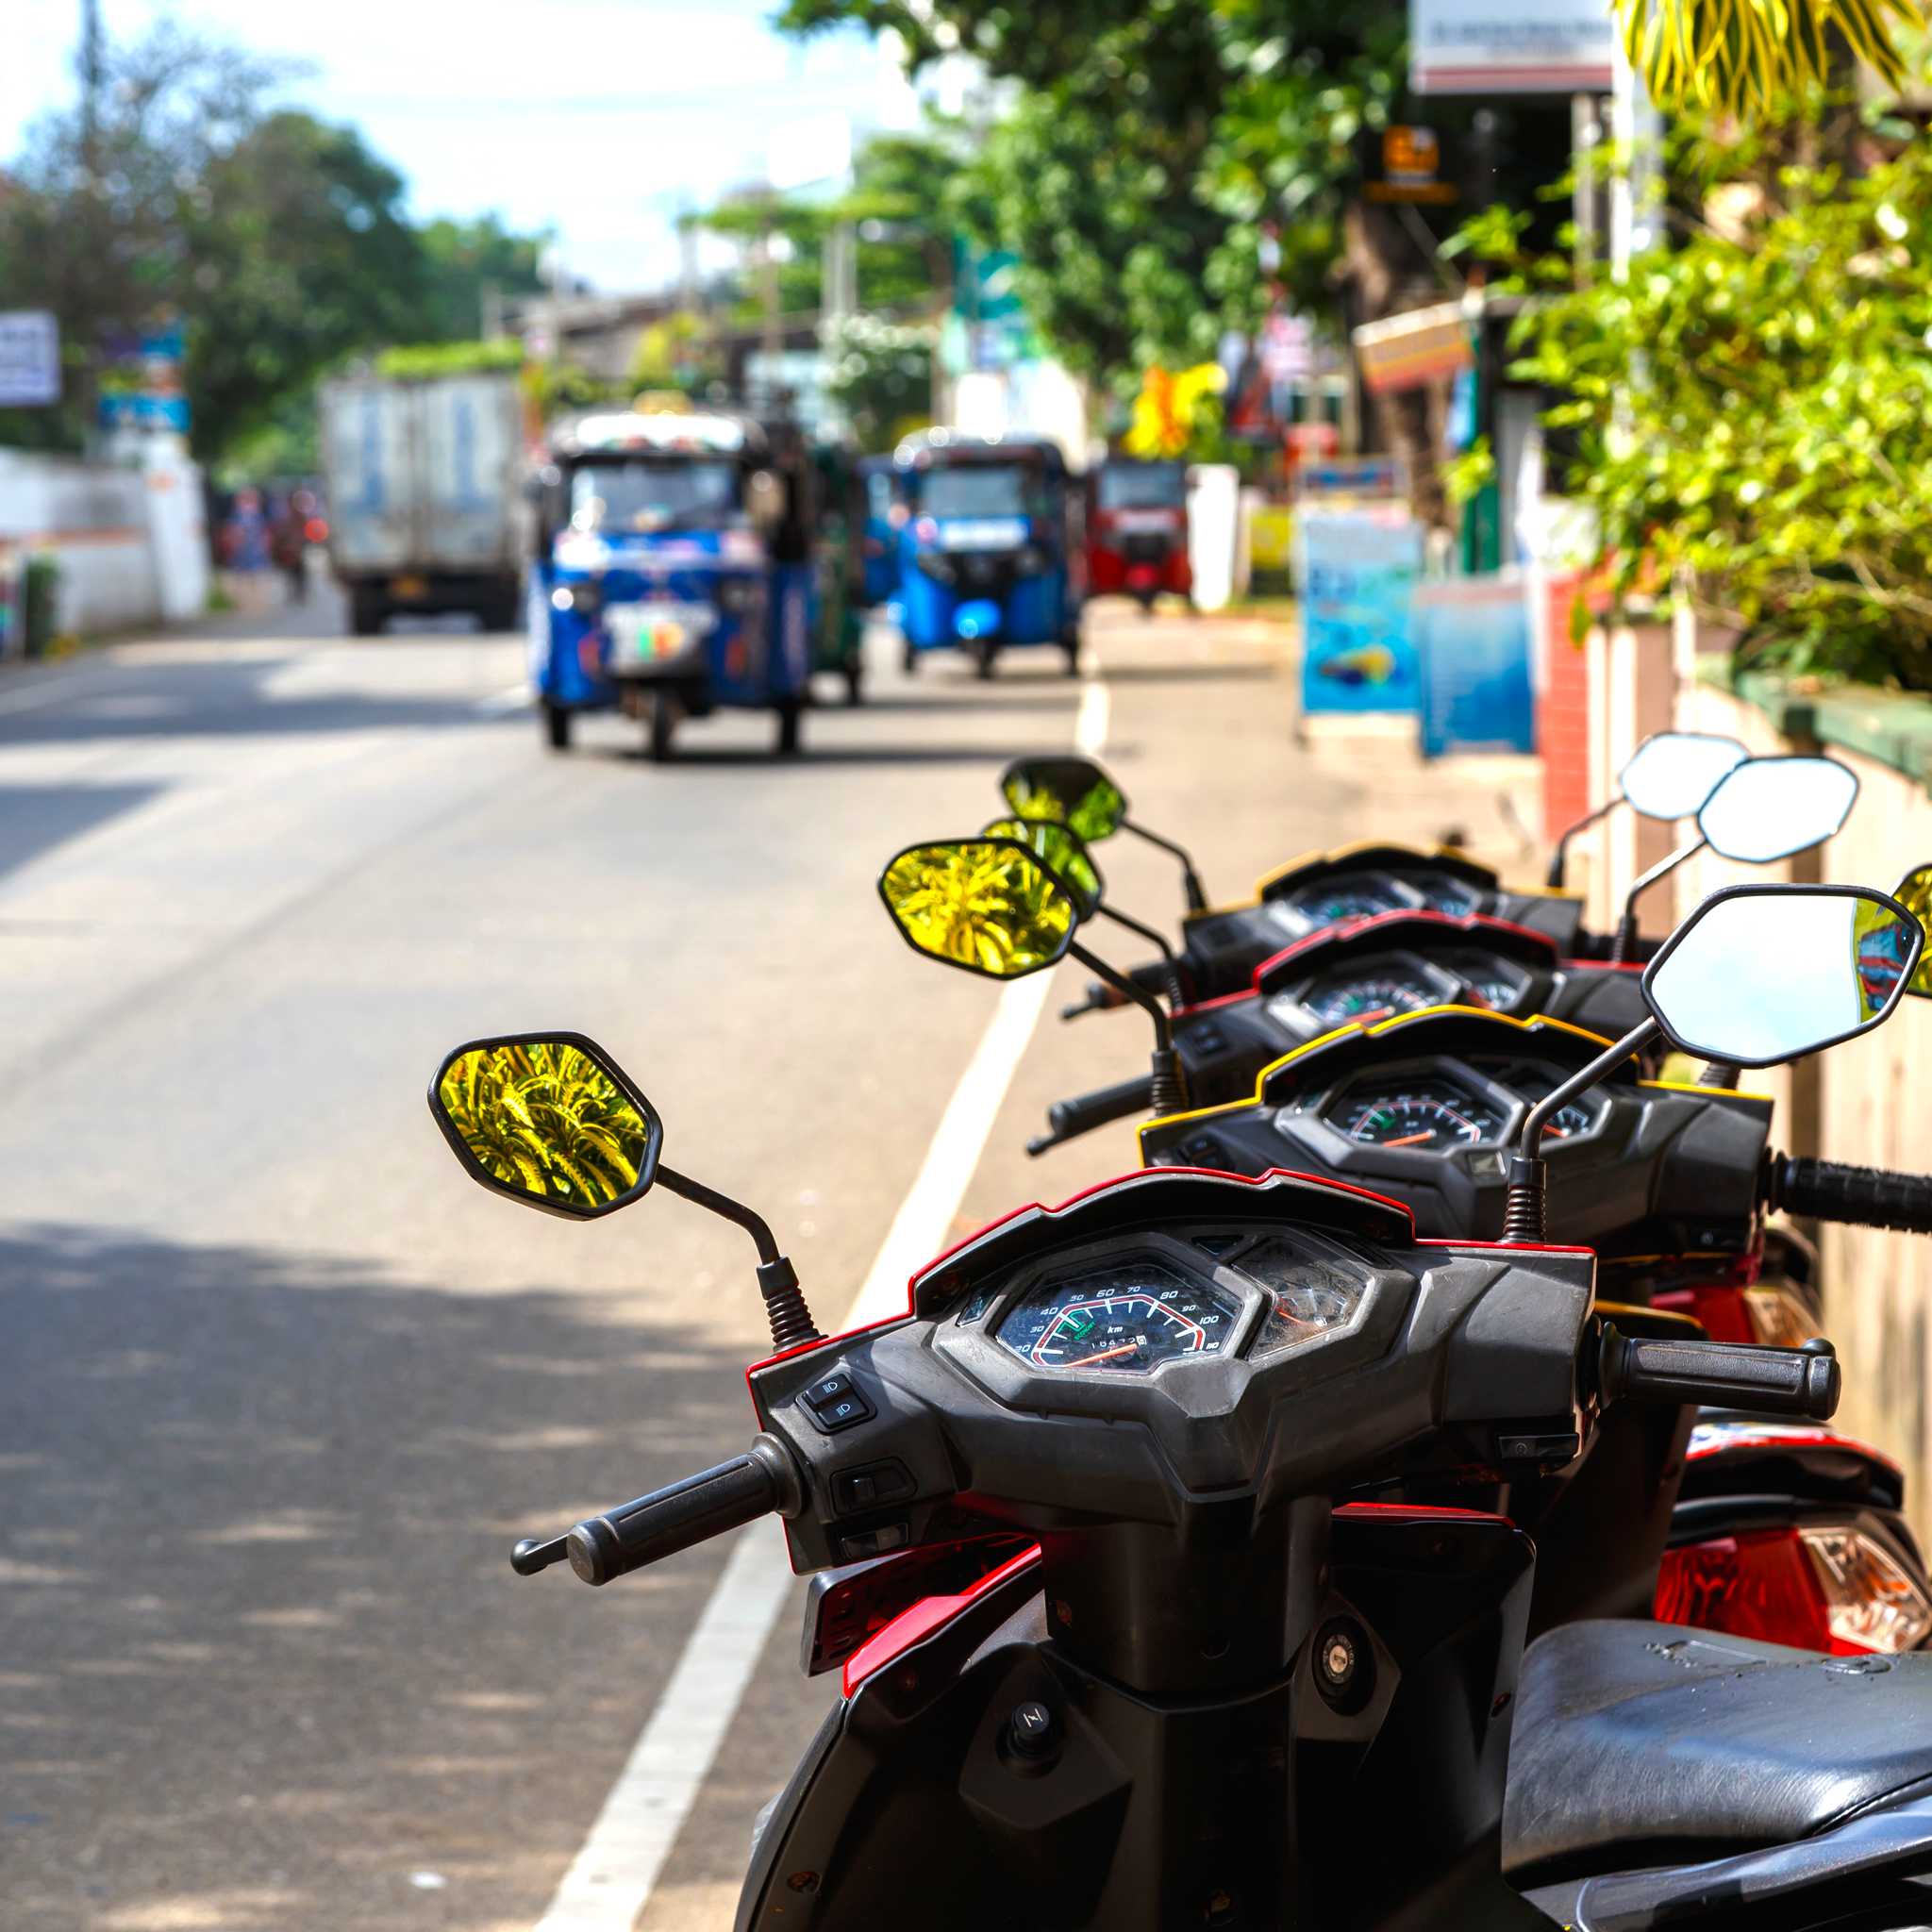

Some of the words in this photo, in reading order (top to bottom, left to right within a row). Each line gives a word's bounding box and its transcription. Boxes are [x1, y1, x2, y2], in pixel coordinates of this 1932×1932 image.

[1096, 1289, 1115, 1298] 60
[1160, 1291, 1178, 1300] 80
[1199, 1315, 1220, 1325] 100
[1107, 1325, 1123, 1334] km
[1015, 1344, 1031, 1353] 20
